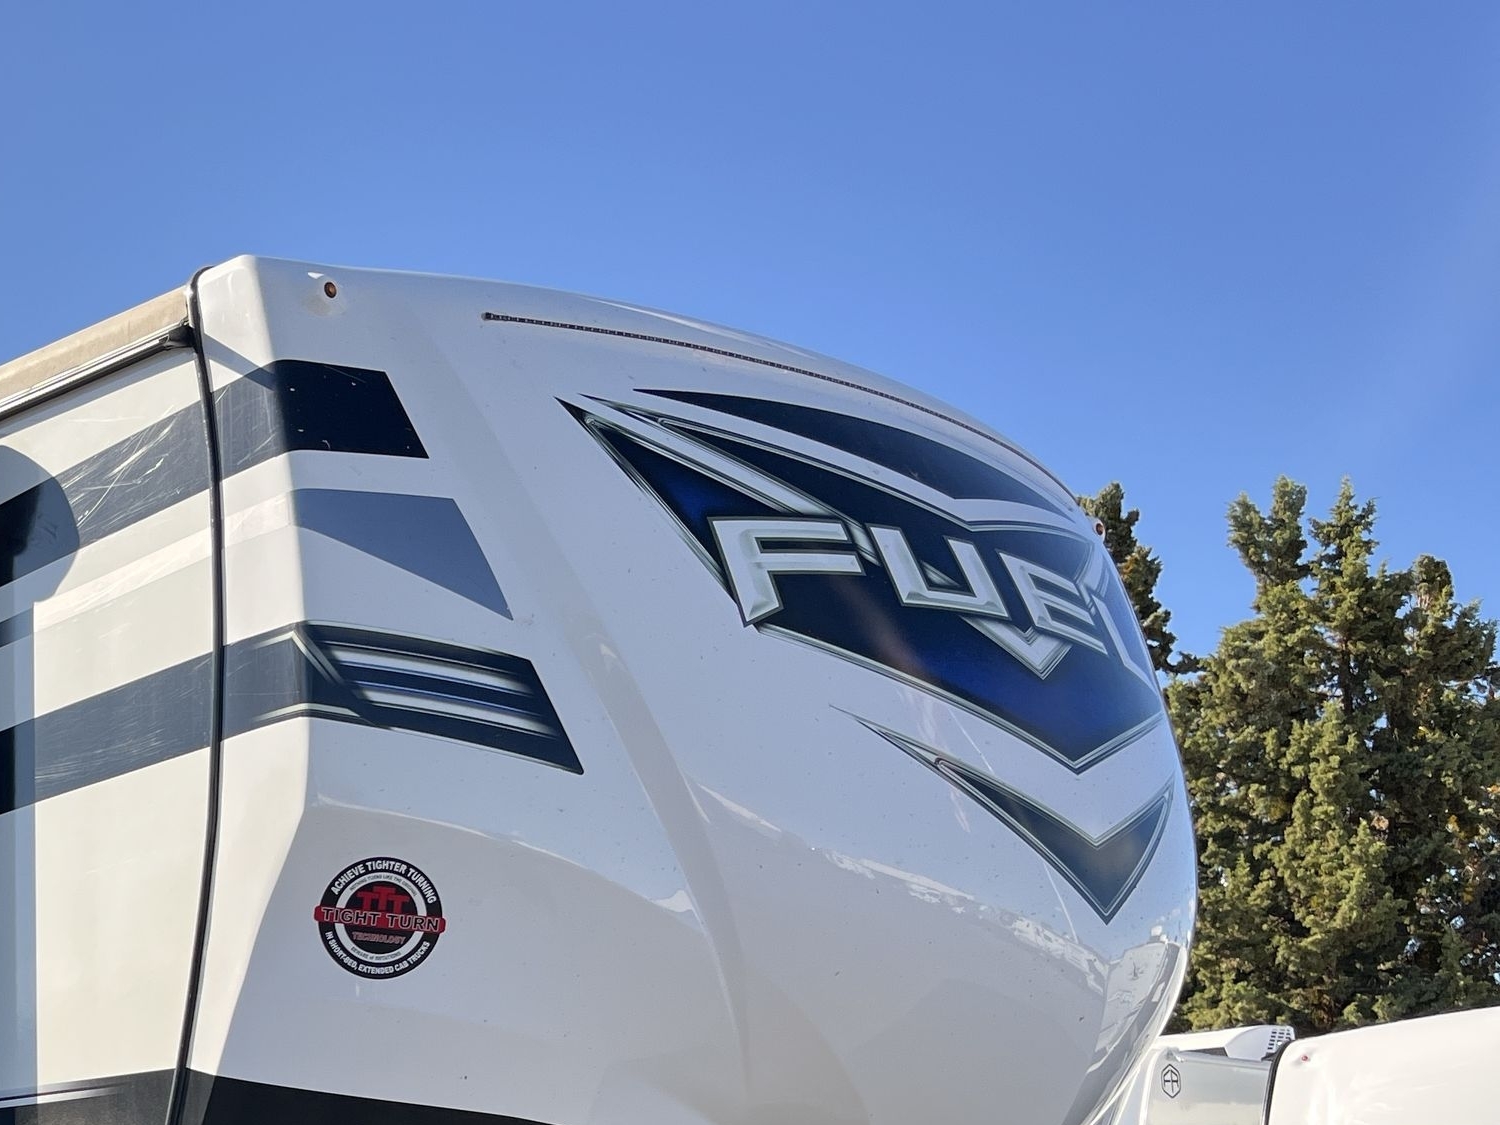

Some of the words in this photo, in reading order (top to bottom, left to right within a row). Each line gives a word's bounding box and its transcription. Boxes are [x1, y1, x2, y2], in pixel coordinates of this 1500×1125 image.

[331, 864, 366, 895] ACHIEVE
[366, 860, 407, 875] TIGHTER
[407, 868, 437, 904] TURNING
[321, 907, 381, 926] TIGHT
[386, 913, 440, 932] TURN
[325, 931, 334, 940] IN
[358, 965, 394, 975] EXTENDED
[394, 960, 409, 971] CAB
[407, 941, 431, 964] TRUCKS
[352, 931, 407, 944] TECHNOLOGY
